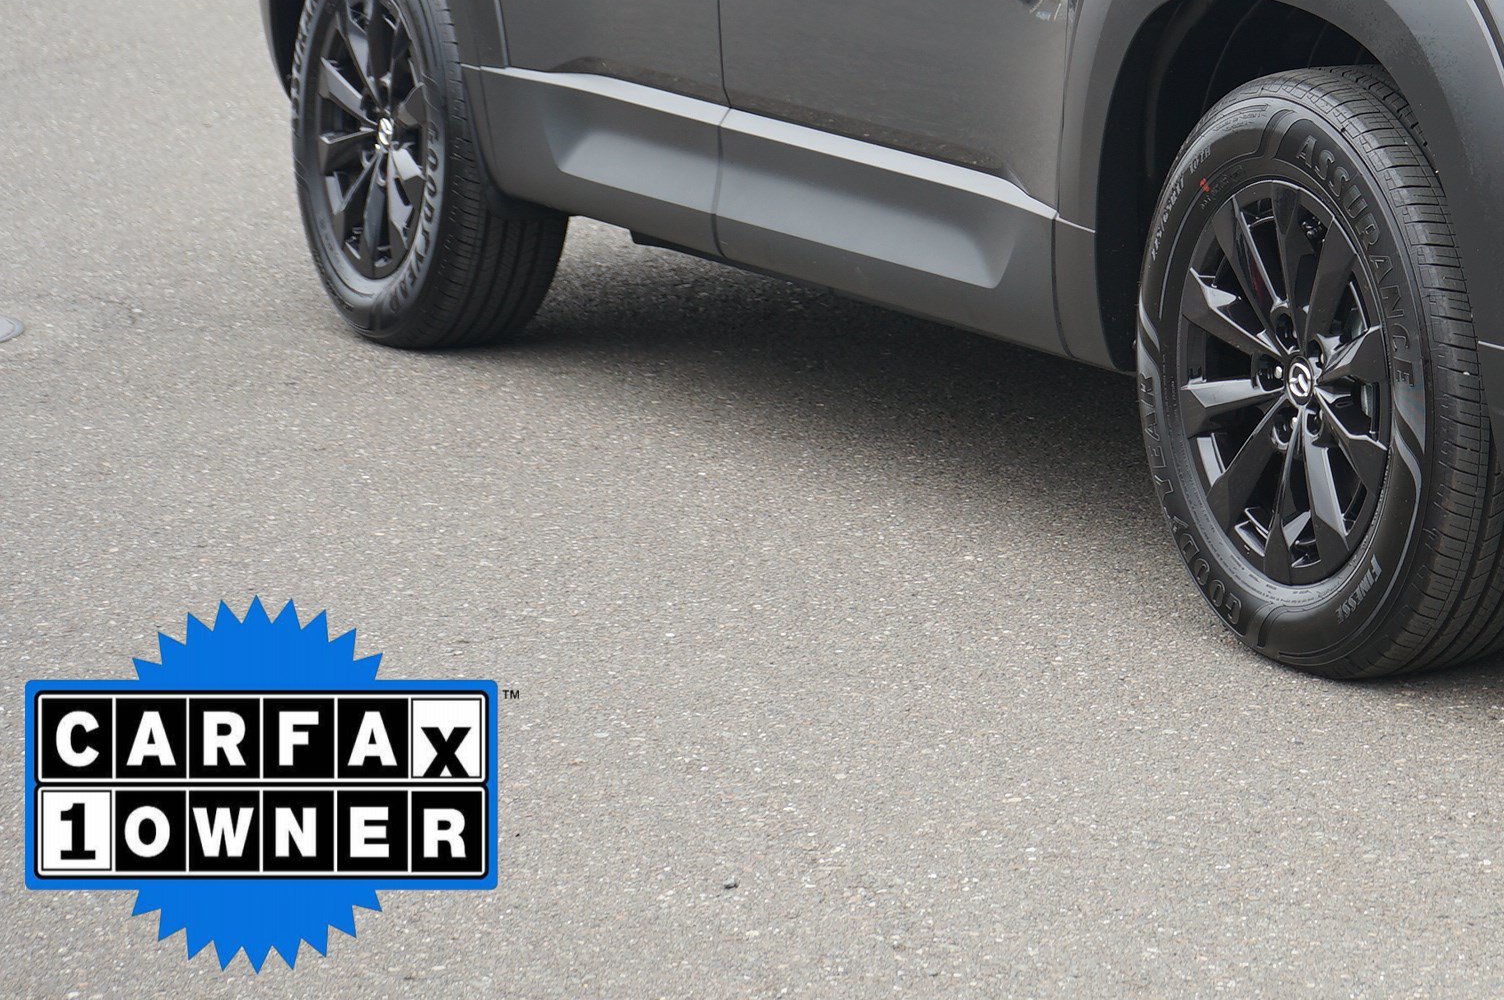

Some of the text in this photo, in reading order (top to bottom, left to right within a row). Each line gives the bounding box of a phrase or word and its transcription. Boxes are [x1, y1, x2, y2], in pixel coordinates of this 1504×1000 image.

[1296, 134, 1415, 388] ASSURANCE
[1140, 371, 1243, 625] GOODYEAR
[1336, 553, 1383, 625] FINESSE
